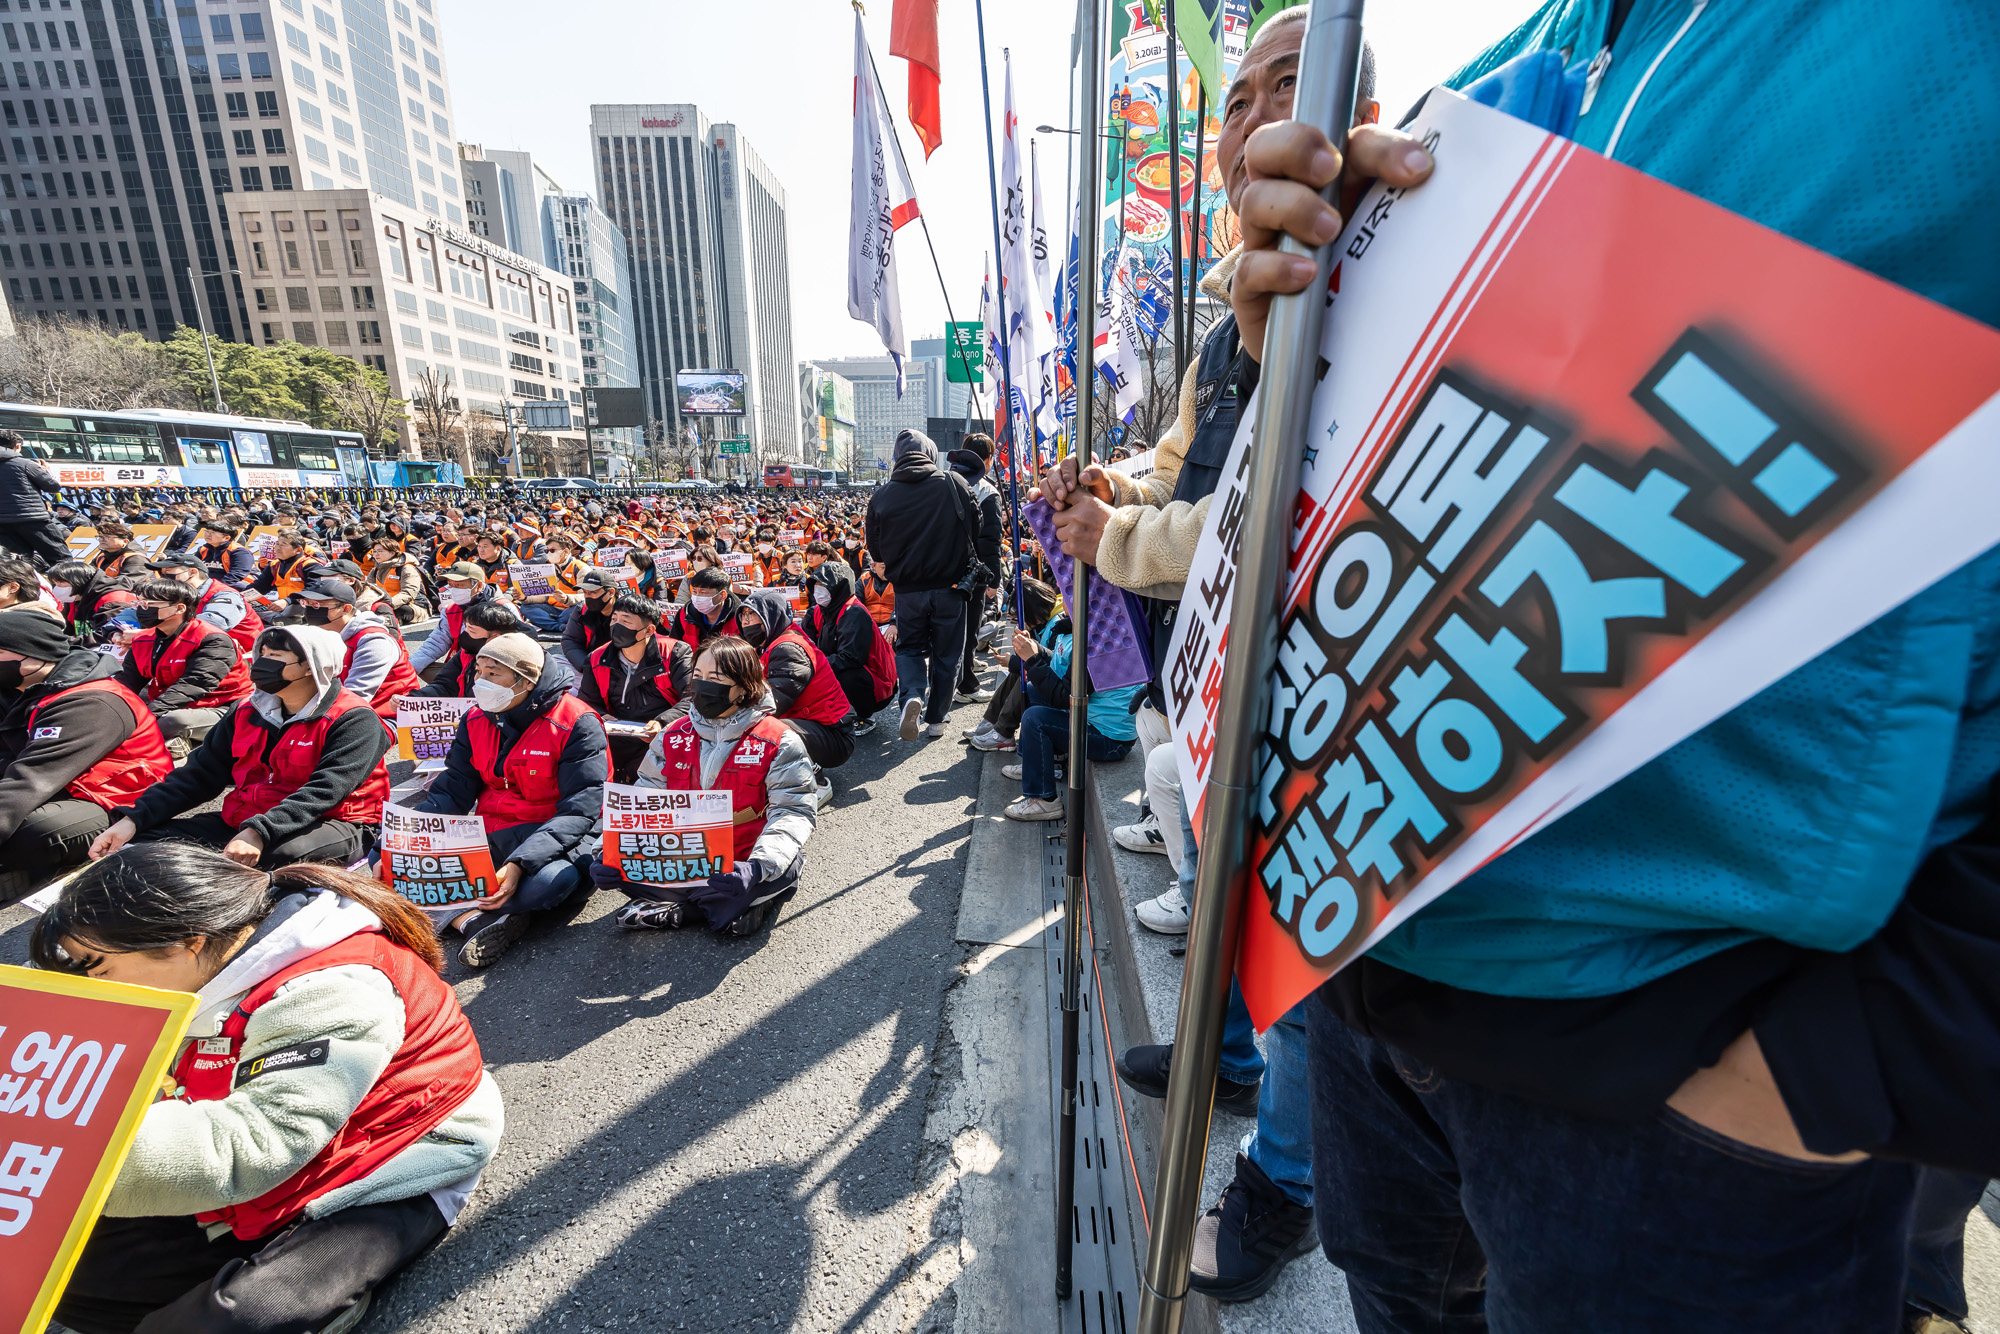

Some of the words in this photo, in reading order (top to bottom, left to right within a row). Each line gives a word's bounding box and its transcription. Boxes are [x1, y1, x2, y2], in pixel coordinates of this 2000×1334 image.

[1237, 4, 1247, 13] UK
[1135, 45, 1162, 60] 3.20(금)
[642, 116, 678, 129] kobaco
[720, 150, 733, 198] 서울신문
[450, 227, 481, 251] SEOUL
[60, 470, 105, 482] 홈런의
[117, 469, 145, 480] 순간
[1259, 382, 1550, 823] 쟁으로
[1263, 350, 1840, 958] 쟁취하자!
[1169, 607, 1211, 728] 모든
[399, 700, 442, 712] 진짜사장
[421, 709, 462, 724] 나와라!
[411, 726, 458, 742] 원청교
[669, 734, 694, 752] 단결
[738, 740, 766, 758] 투쟁
[606, 791, 632, 811] 모든
[634, 793, 692, 811] 노동자의
[385, 810, 401, 831] 모든
[402, 816, 446, 834] 노동자의
[609, 813, 675, 830] 노동기본권
[385, 833, 432, 851] 노동기본권
[619, 832, 706, 857] 투쟁으로
[391, 854, 466, 880] 투쟁으로
[621, 856, 722, 882] 쟁취하자!
[392, 876, 486, 906] 쟁취하자!
[263, 1054, 308, 1069] GEOGRAPHIC
[266, 1050, 299, 1062] NATIONAL
